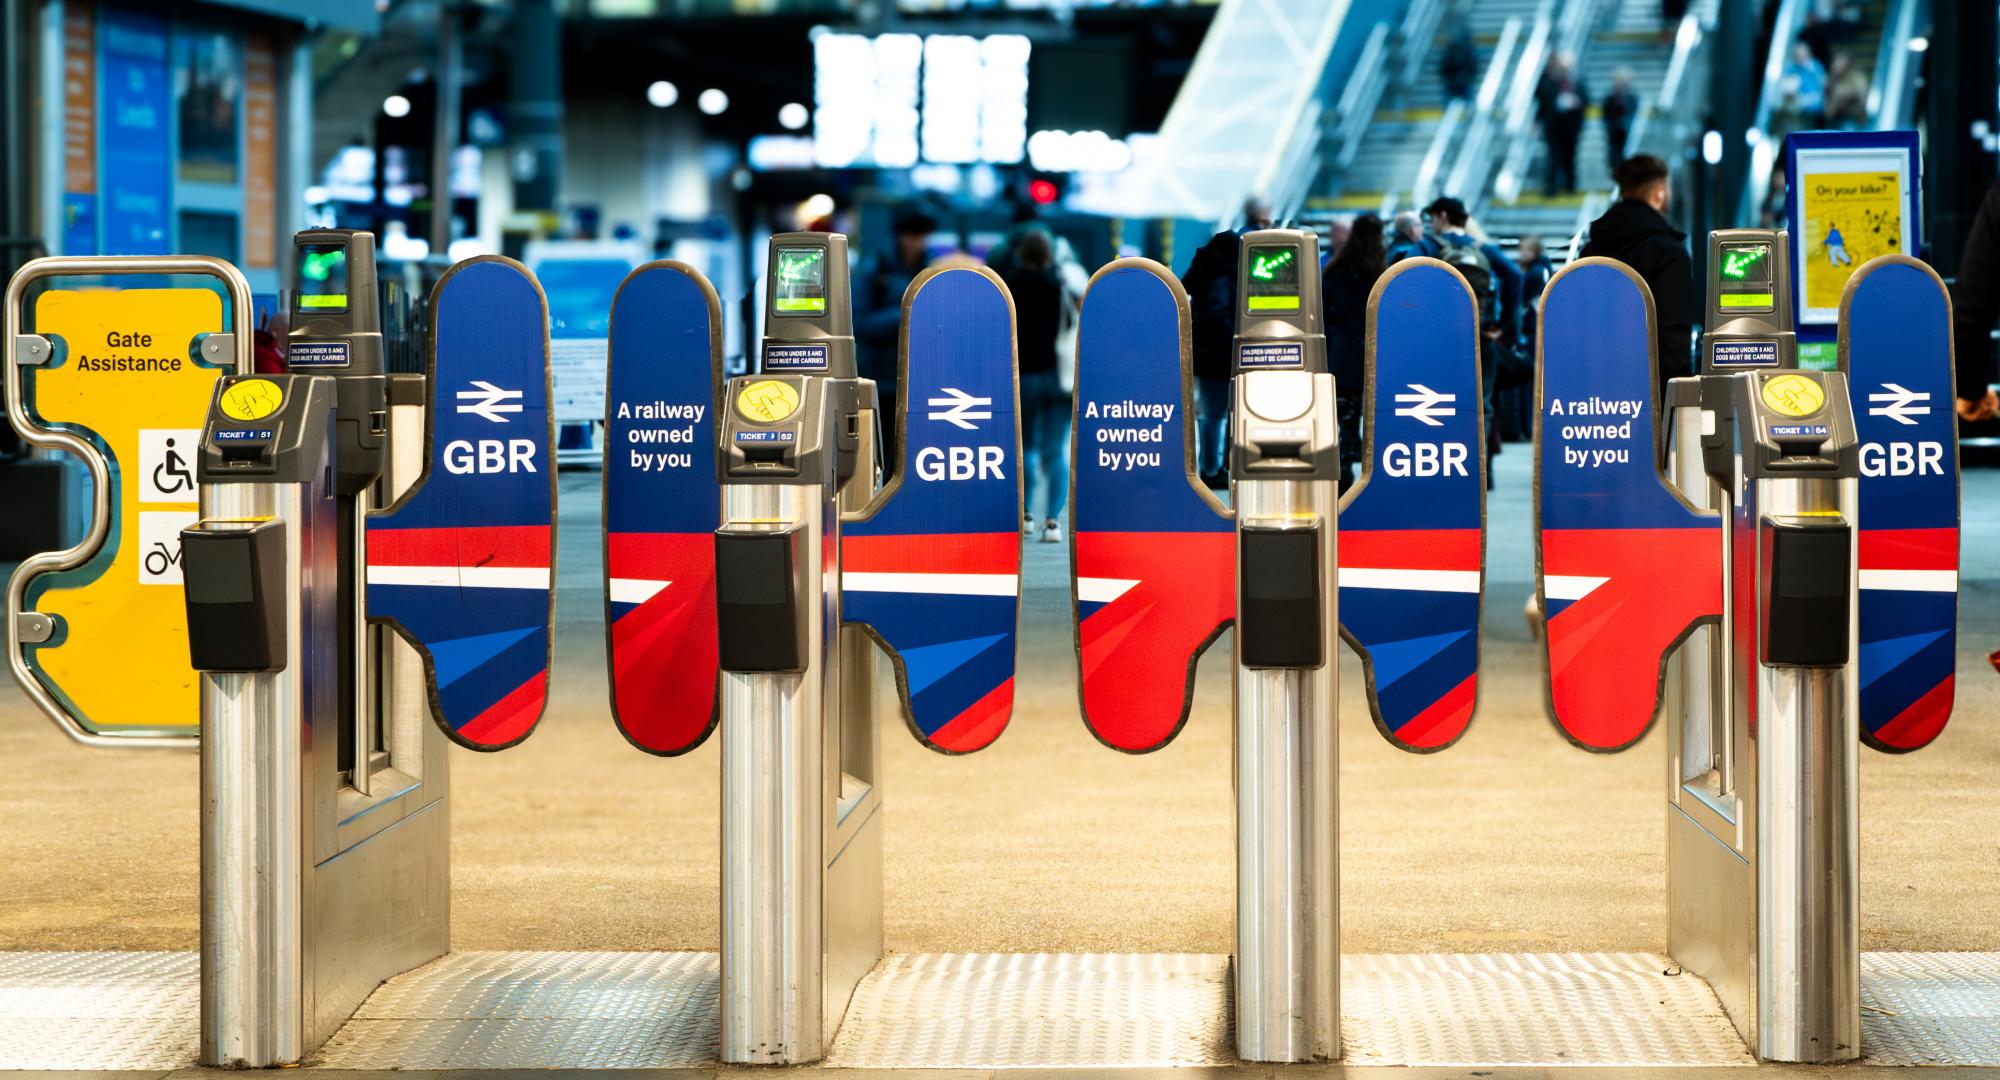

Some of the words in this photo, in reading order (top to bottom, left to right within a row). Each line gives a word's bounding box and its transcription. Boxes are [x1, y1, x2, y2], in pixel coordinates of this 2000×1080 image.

[1816, 185, 1832, 196] On
[1835, 187, 1858, 198] your
[1861, 184, 1888, 195] bike?
[107, 331, 152, 348] Gate
[77, 354, 182, 371] Assistance
[617, 402, 631, 419] A
[635, 400, 705, 423] railway
[1085, 401, 1099, 418] A
[1103, 399, 1175, 423] railway
[1549, 398, 1565, 416] A
[1568, 397, 1643, 419] railway
[219, 431, 246, 439] TICKET
[628, 424, 693, 443] owned
[1096, 423, 1163, 443] owned
[1561, 420, 1631, 440] owned
[443, 439, 537, 475] GBR
[630, 449, 654, 472] by
[656, 454, 691, 472] you
[915, 446, 1006, 482] GBR
[1099, 449, 1122, 471] by
[1125, 453, 1161, 471] you
[1382, 443, 1469, 478] GBR
[1564, 445, 1589, 468] by
[1592, 450, 1629, 468] you
[1858, 441, 1945, 478] GBR
